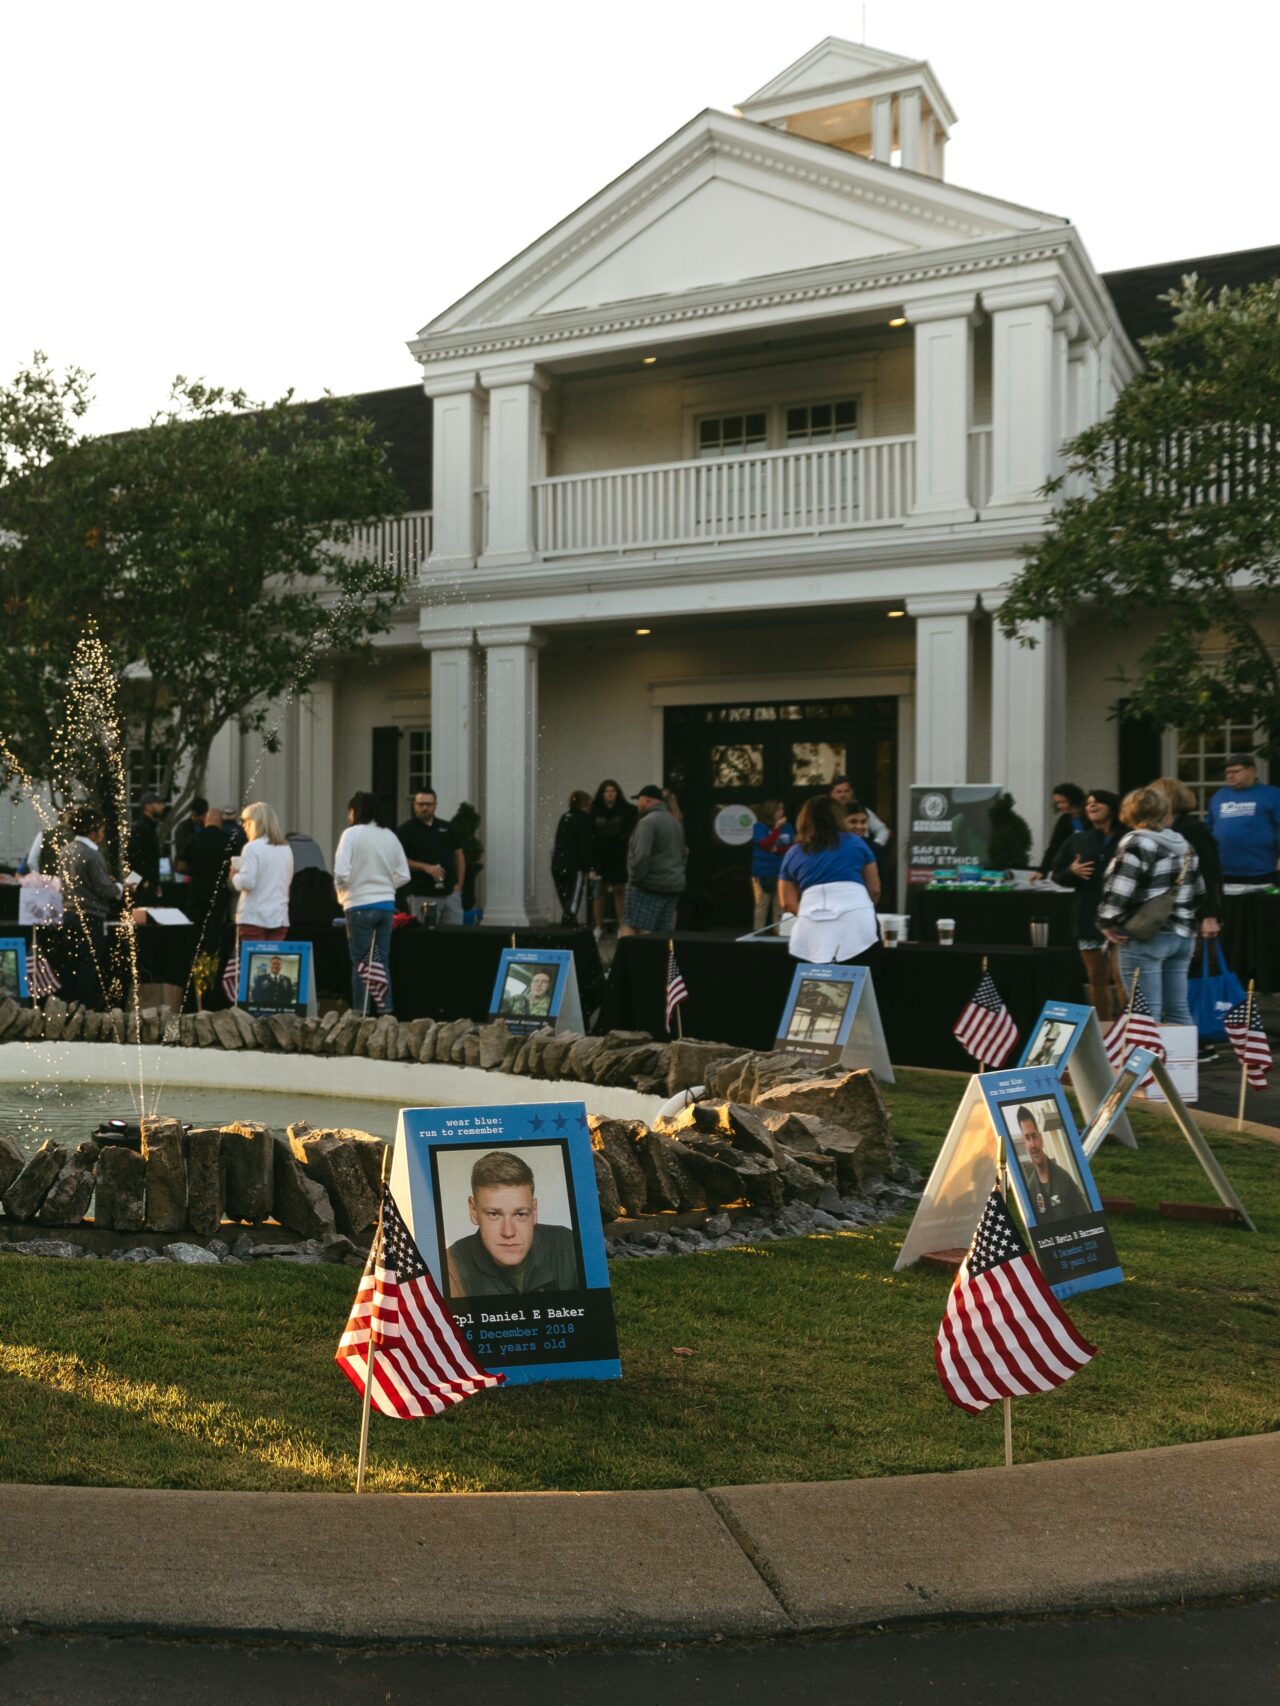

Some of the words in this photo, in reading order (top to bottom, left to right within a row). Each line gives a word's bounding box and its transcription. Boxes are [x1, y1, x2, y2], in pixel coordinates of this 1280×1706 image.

[912, 846, 958, 855] SAFETY
[912, 856, 935, 865] AND
[937, 856, 980, 865] ETHICS
[474, 1117, 502, 1125] blue:
[458, 1126, 504, 1135] remember
[481, 1311, 526, 1322] Daniel
[533, 1310, 541, 1319] E
[547, 1308, 584, 1318] Baker
[466, 1330, 473, 1340] 6
[480, 1327, 538, 1339] December
[546, 1323, 575, 1334] 2018
[478, 1344, 492, 1354] 21
[500, 1343, 536, 1355] years
[544, 1338, 566, 1349] old
